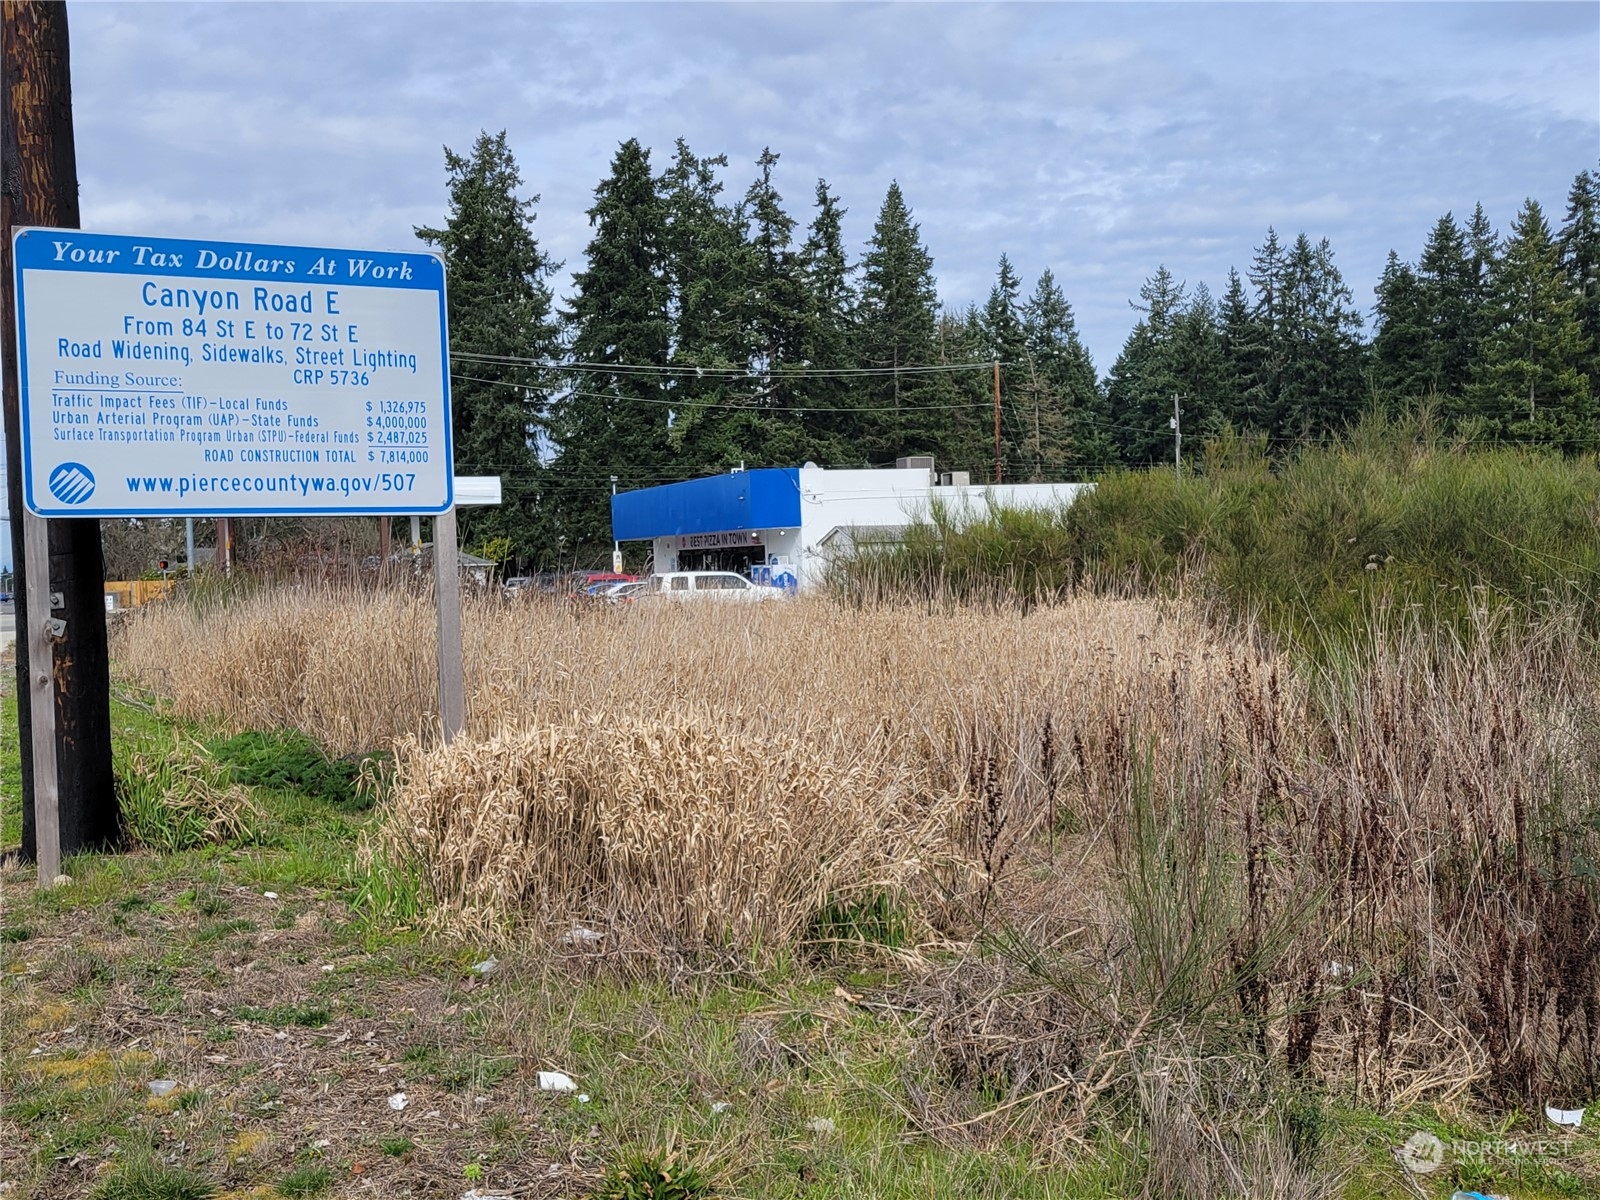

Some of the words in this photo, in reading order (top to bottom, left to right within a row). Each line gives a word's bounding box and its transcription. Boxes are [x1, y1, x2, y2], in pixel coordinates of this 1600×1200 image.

[52, 241, 120, 264] Your
[132, 245, 183, 267] Tax
[195, 249, 296, 274] Dollars
[307, 256, 337, 276] At
[347, 258, 413, 281] Work
[142, 281, 239, 316] Canyon
[254, 286, 312, 313] Road
[326, 290, 340, 315] E
[124, 315, 173, 336] From
[182, 318, 207, 337] 84
[216, 319, 235, 338] St
[245, 320, 256, 339] E
[265, 321, 284, 341] to
[290, 322, 313, 341] 72
[321, 323, 338, 342] St
[348, 325, 359, 343] E
[58, 338, 102, 359] Road
[112, 340, 193, 367] Widening,
[202, 343, 288, 366] Sidewalks,
[295, 346, 344, 367] Street
[353, 348, 417, 374] Lighting
[54, 370, 120, 389] Funding
[125, 371, 182, 388] Source:
[293, 369, 324, 385] CRP
[330, 370, 369, 386] 5736
[52, 393, 93, 407] Traffic
[100, 394, 142, 411] Impact
[149, 395, 175, 409] Fees
[256, 397, 288, 411] Funds
[52, 410, 89, 424] Urban
[96, 411, 146, 425] Arterial
[152, 412, 202, 429] Program
[287, 414, 319, 427] Funds
[54, 427, 94, 441] Surface
[98, 427, 175, 445] Transportation
[180, 429, 221, 446] Program
[226, 429, 254, 442] Urban
[333, 431, 359, 444] Funds
[204, 449, 234, 462] ROAD
[240, 449, 320, 462] CONSTRUCTION
[325, 450, 356, 463] TOTAL
[126, 473, 416, 498] www.piercecountywa.gov/507
[690, 536, 702, 547] BEST
[704, 534, 720, 546] PIZZA
[722, 534, 728, 545] IN
[729, 532, 748, 544] TOWN
